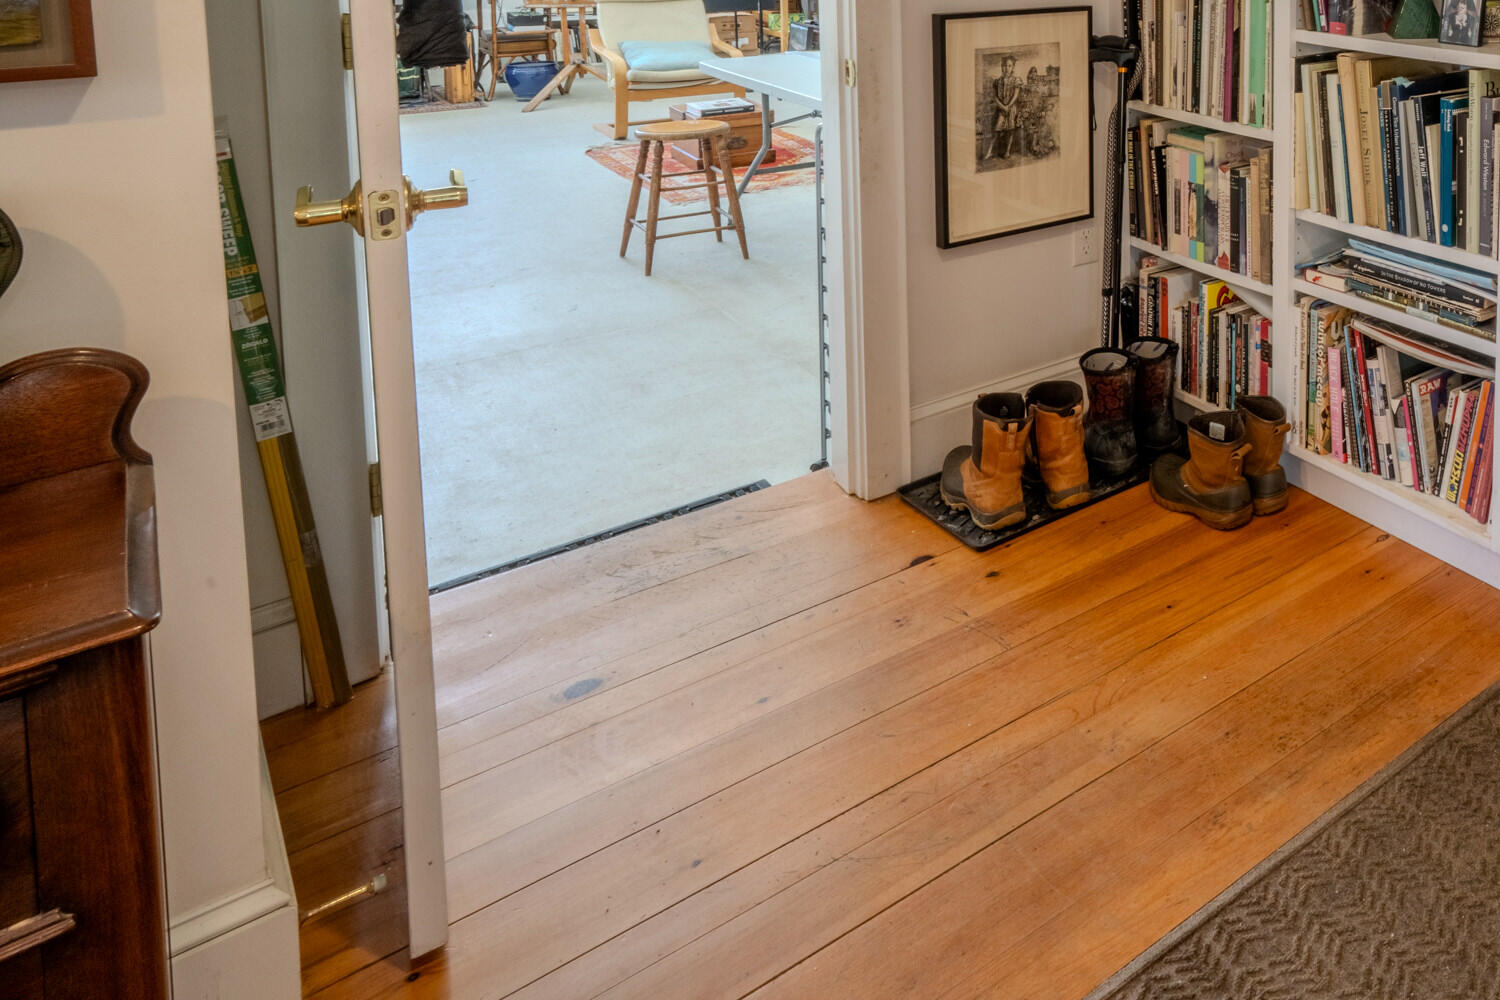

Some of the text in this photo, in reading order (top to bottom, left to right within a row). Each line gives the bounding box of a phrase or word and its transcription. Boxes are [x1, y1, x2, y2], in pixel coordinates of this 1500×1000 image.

[1359, 108, 1369, 141] JOSEF
[1417, 145, 1427, 177] Jeff Wall
[222, 206, 238, 256] SWEEP
[1426, 283, 1446, 293] TOWERS
[1315, 320, 1325, 405] winsor mccay
[1328, 351, 1340, 381] BLACK
[1330, 387, 1341, 412] HOLE
[1418, 377, 1441, 396] RAW
